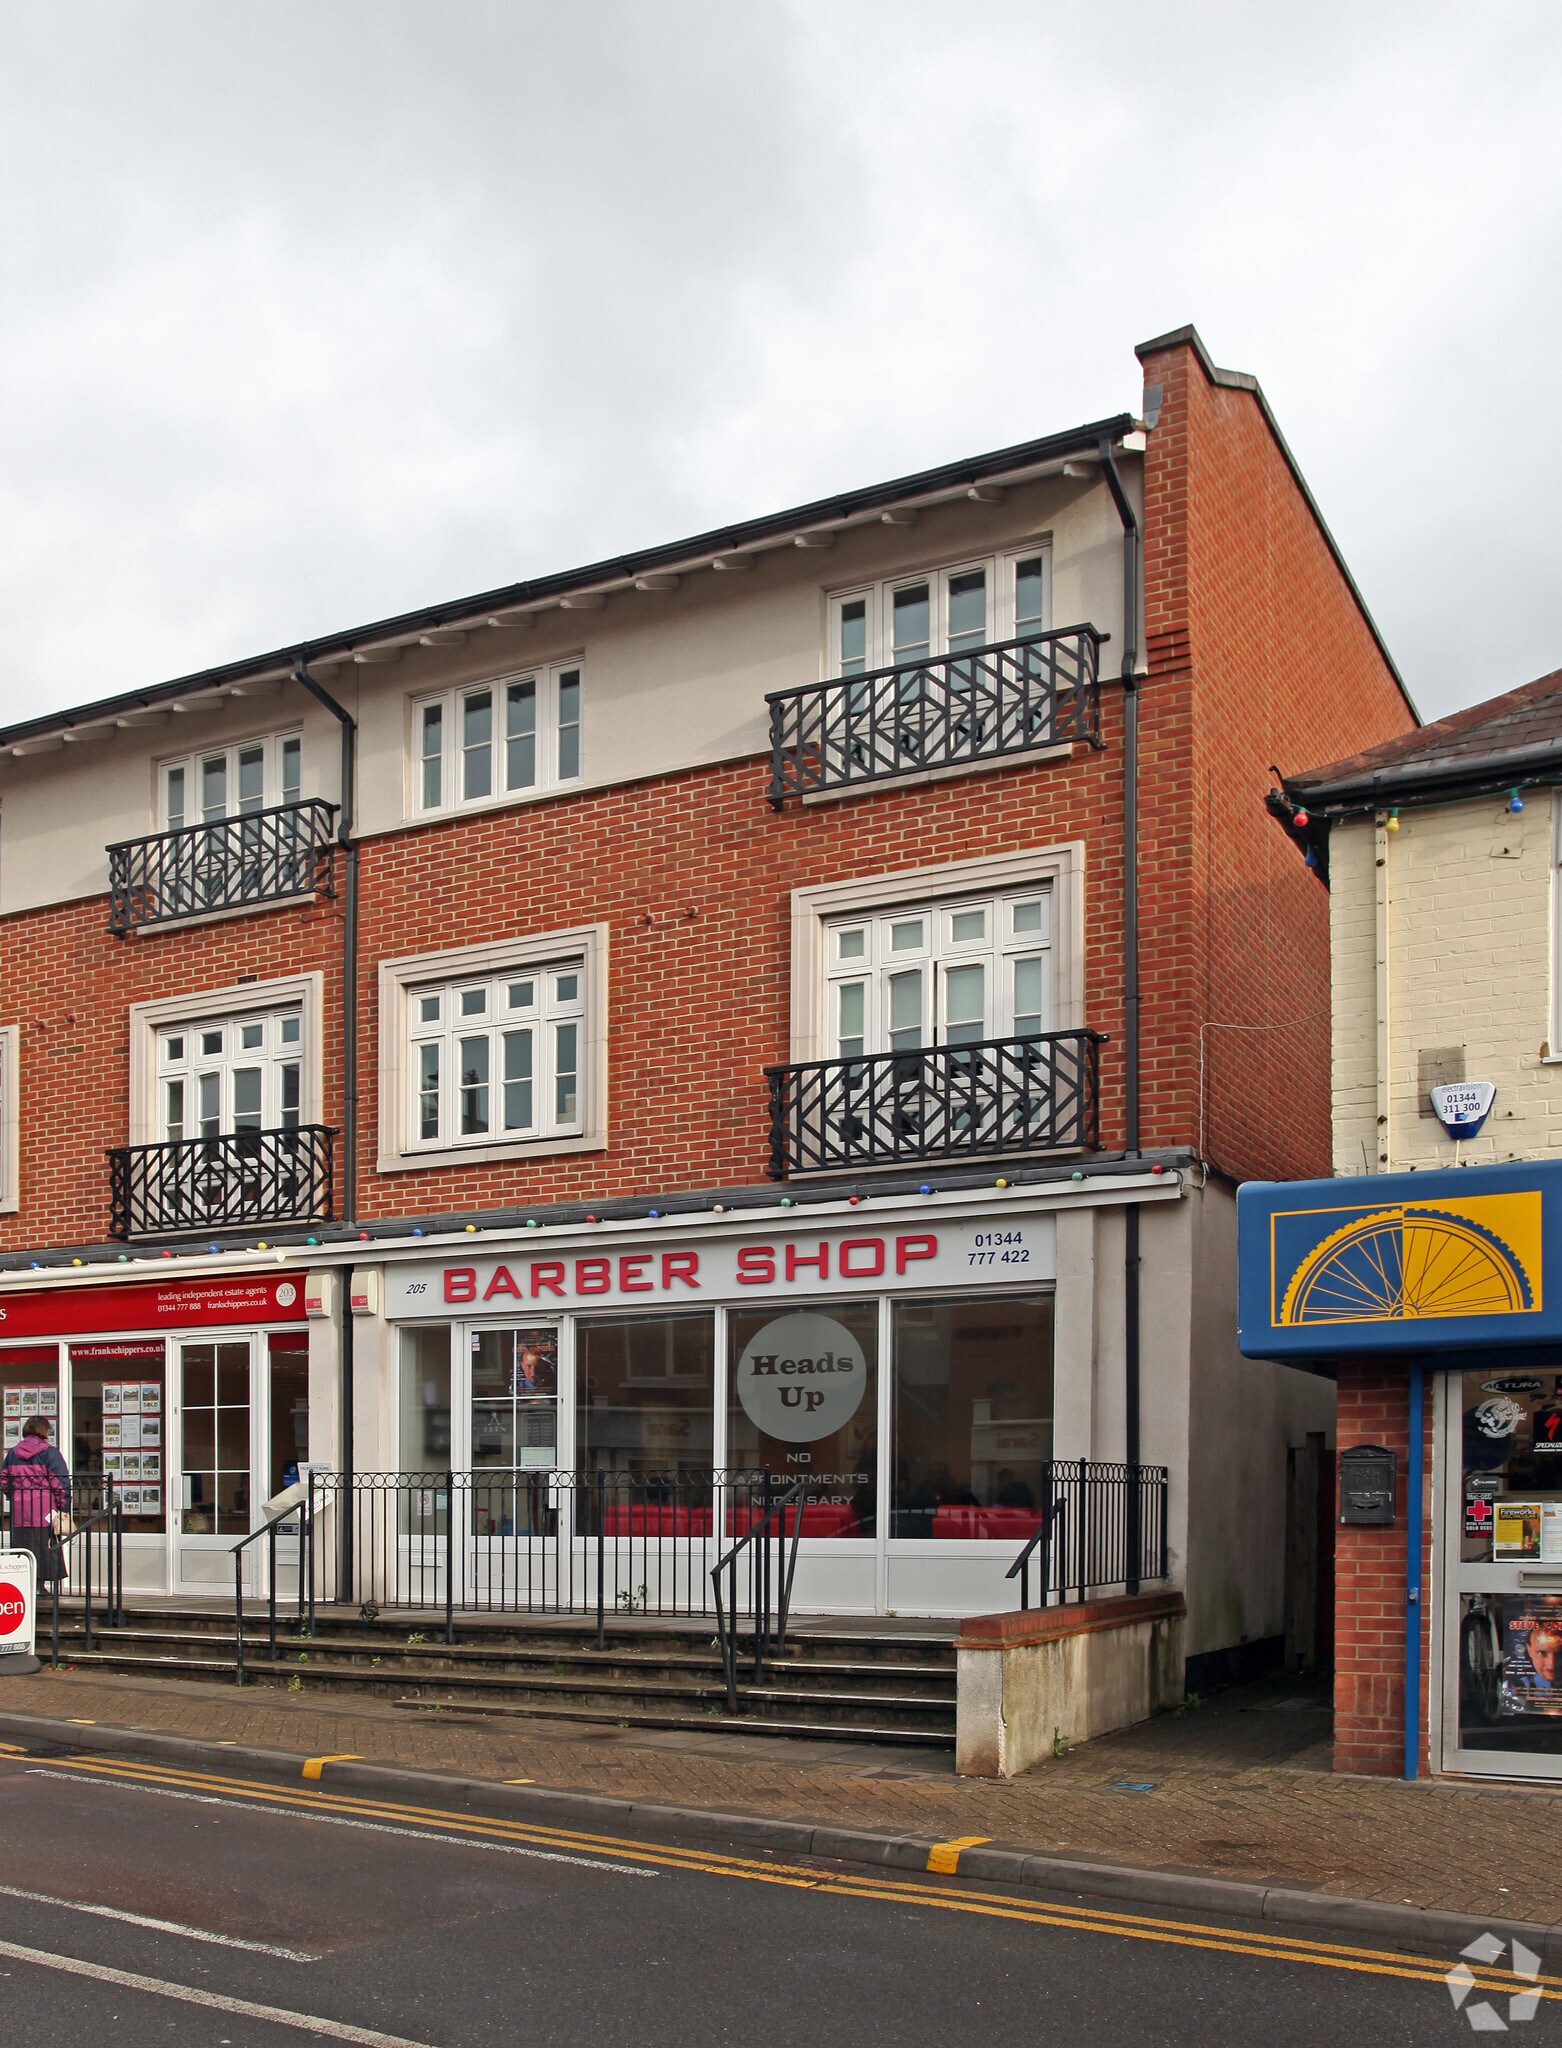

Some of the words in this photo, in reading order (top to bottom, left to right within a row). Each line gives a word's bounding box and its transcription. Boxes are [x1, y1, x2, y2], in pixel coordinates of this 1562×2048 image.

[1442, 1084, 1481, 1093] electravision
[1447, 1093, 1476, 1103] 01344
[1443, 1105, 1459, 1113] 311
[1463, 1103, 1480, 1111] 300
[975, 1232, 1023, 1247] 01344
[968, 1252, 996, 1265] 777
[1001, 1250, 1029, 1263] 422
[443, 1251, 701, 1303] BARBER
[736, 1234, 938, 1284] SHOP
[158, 1292, 182, 1302] leading
[182, 1289, 223, 1300] independent
[245, 1287, 267, 1296] agents
[278, 1288, 294, 1298] 203
[406, 1284, 427, 1295] 205
[158, 1304, 176, 1312] 01344
[177, 1303, 188, 1311] 777
[207, 1298, 267, 1309] frankschippers.co.uk
[71, 1344, 165, 1356] www.frankschippers.co.uk
[750, 1352, 854, 1375] Heads
[1484, 1381, 1541, 1390] ALTURA
[777, 1386, 825, 1412] Up
[786, 1453, 811, 1463] NO
[1509, 1620, 1539, 1630] STEVE
